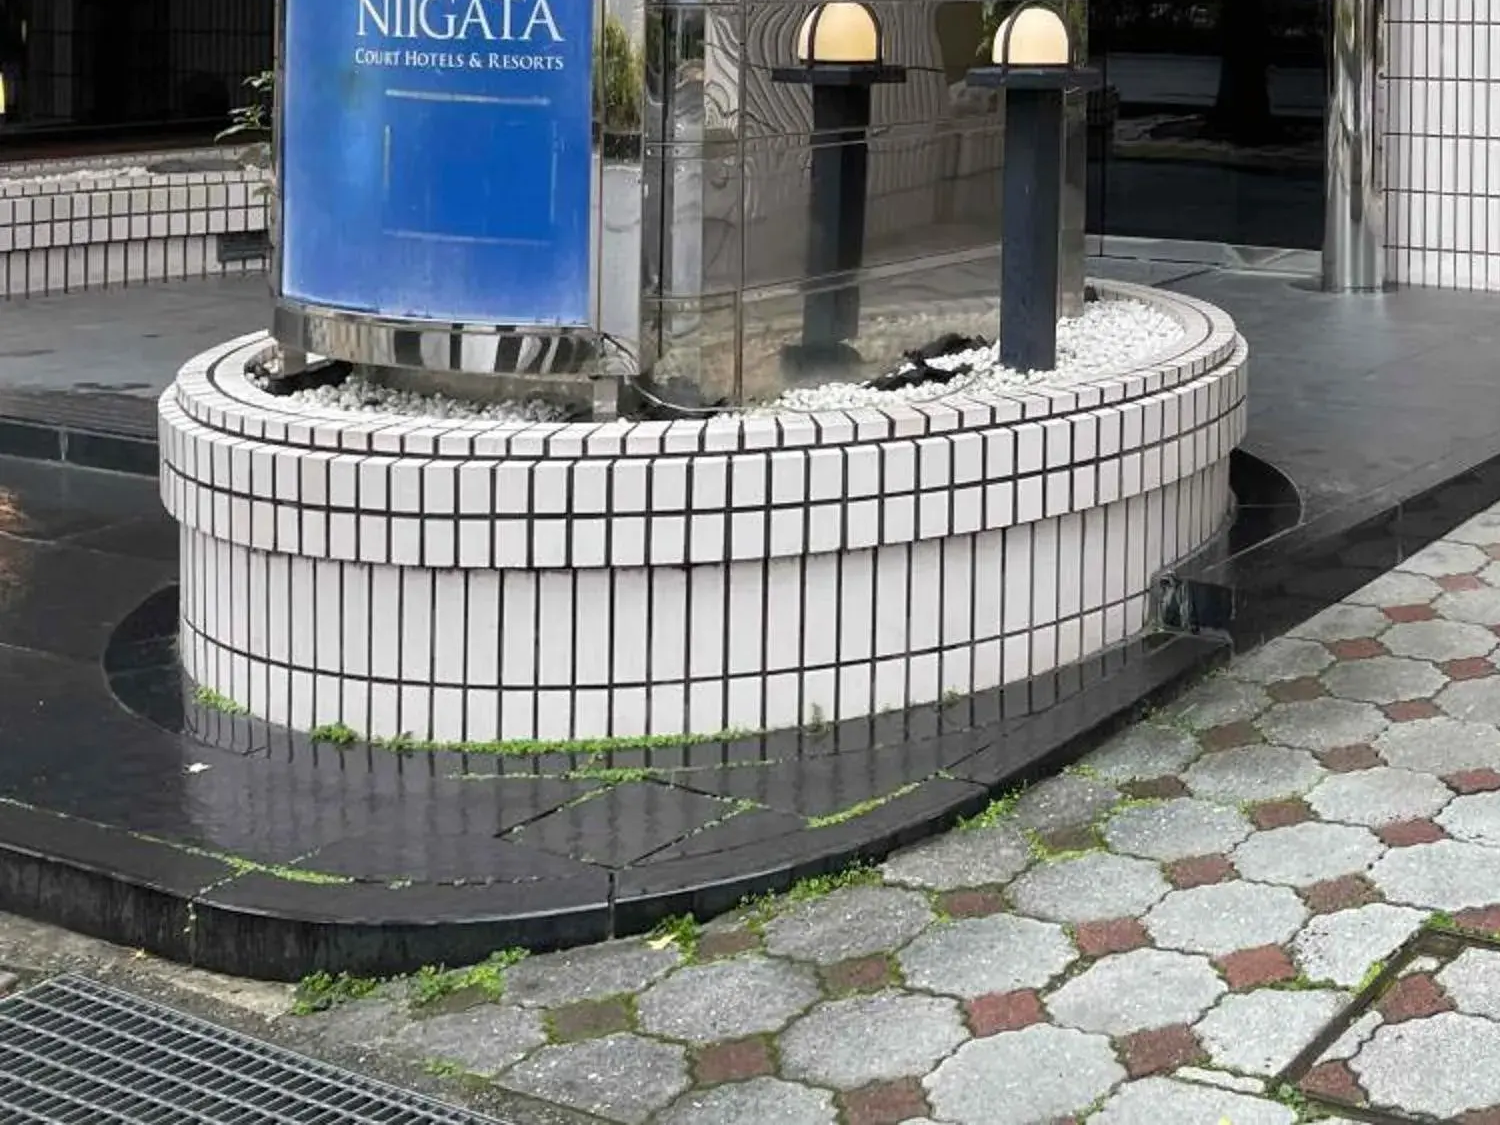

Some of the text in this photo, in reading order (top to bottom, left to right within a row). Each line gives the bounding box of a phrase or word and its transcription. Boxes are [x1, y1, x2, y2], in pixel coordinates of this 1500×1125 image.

[355, 47, 565, 70] COURT HOTELS & RESORTS
